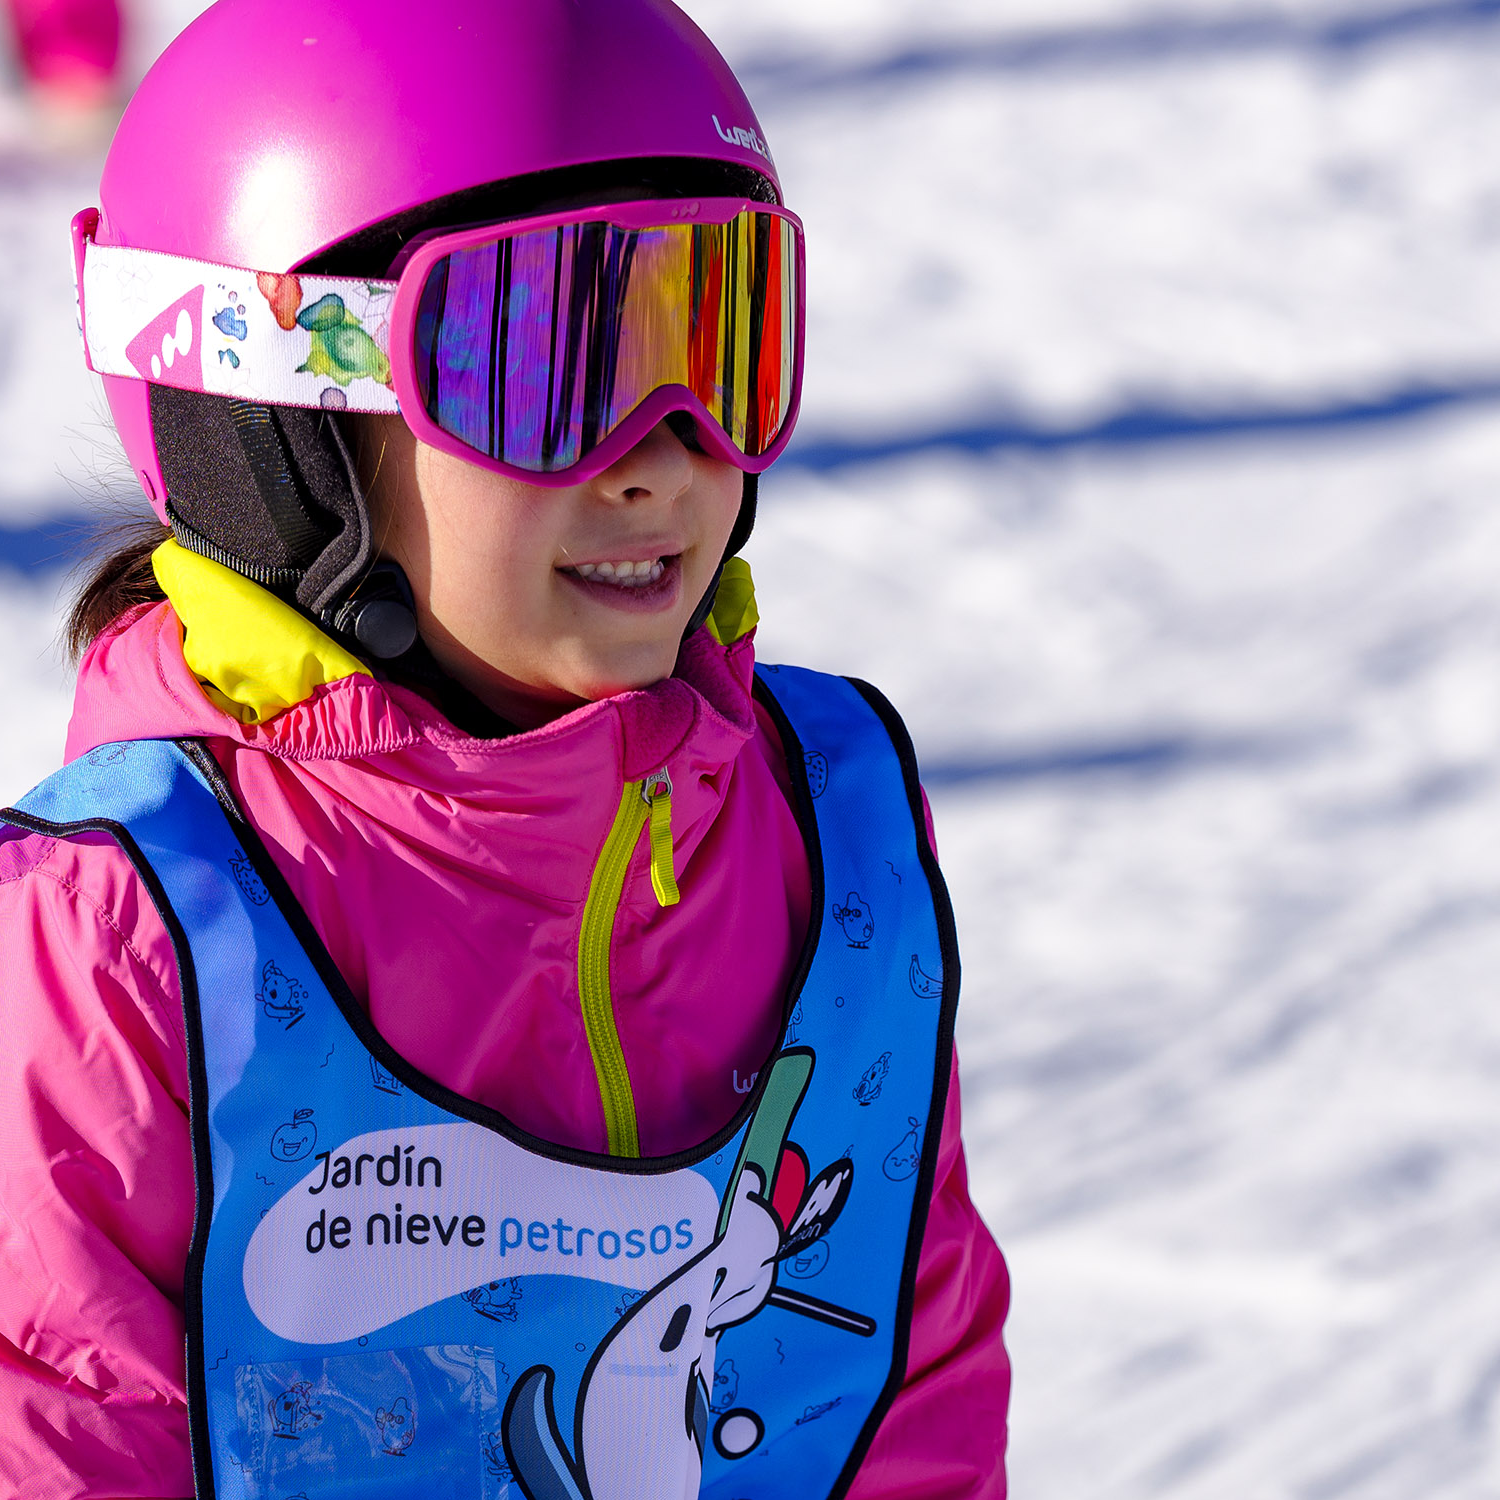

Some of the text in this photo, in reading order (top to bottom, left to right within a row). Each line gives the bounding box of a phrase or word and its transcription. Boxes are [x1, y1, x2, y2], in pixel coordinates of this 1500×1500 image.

[308, 1145, 442, 1195] Jardín
[305, 1204, 695, 1260] de nieve petrosos
